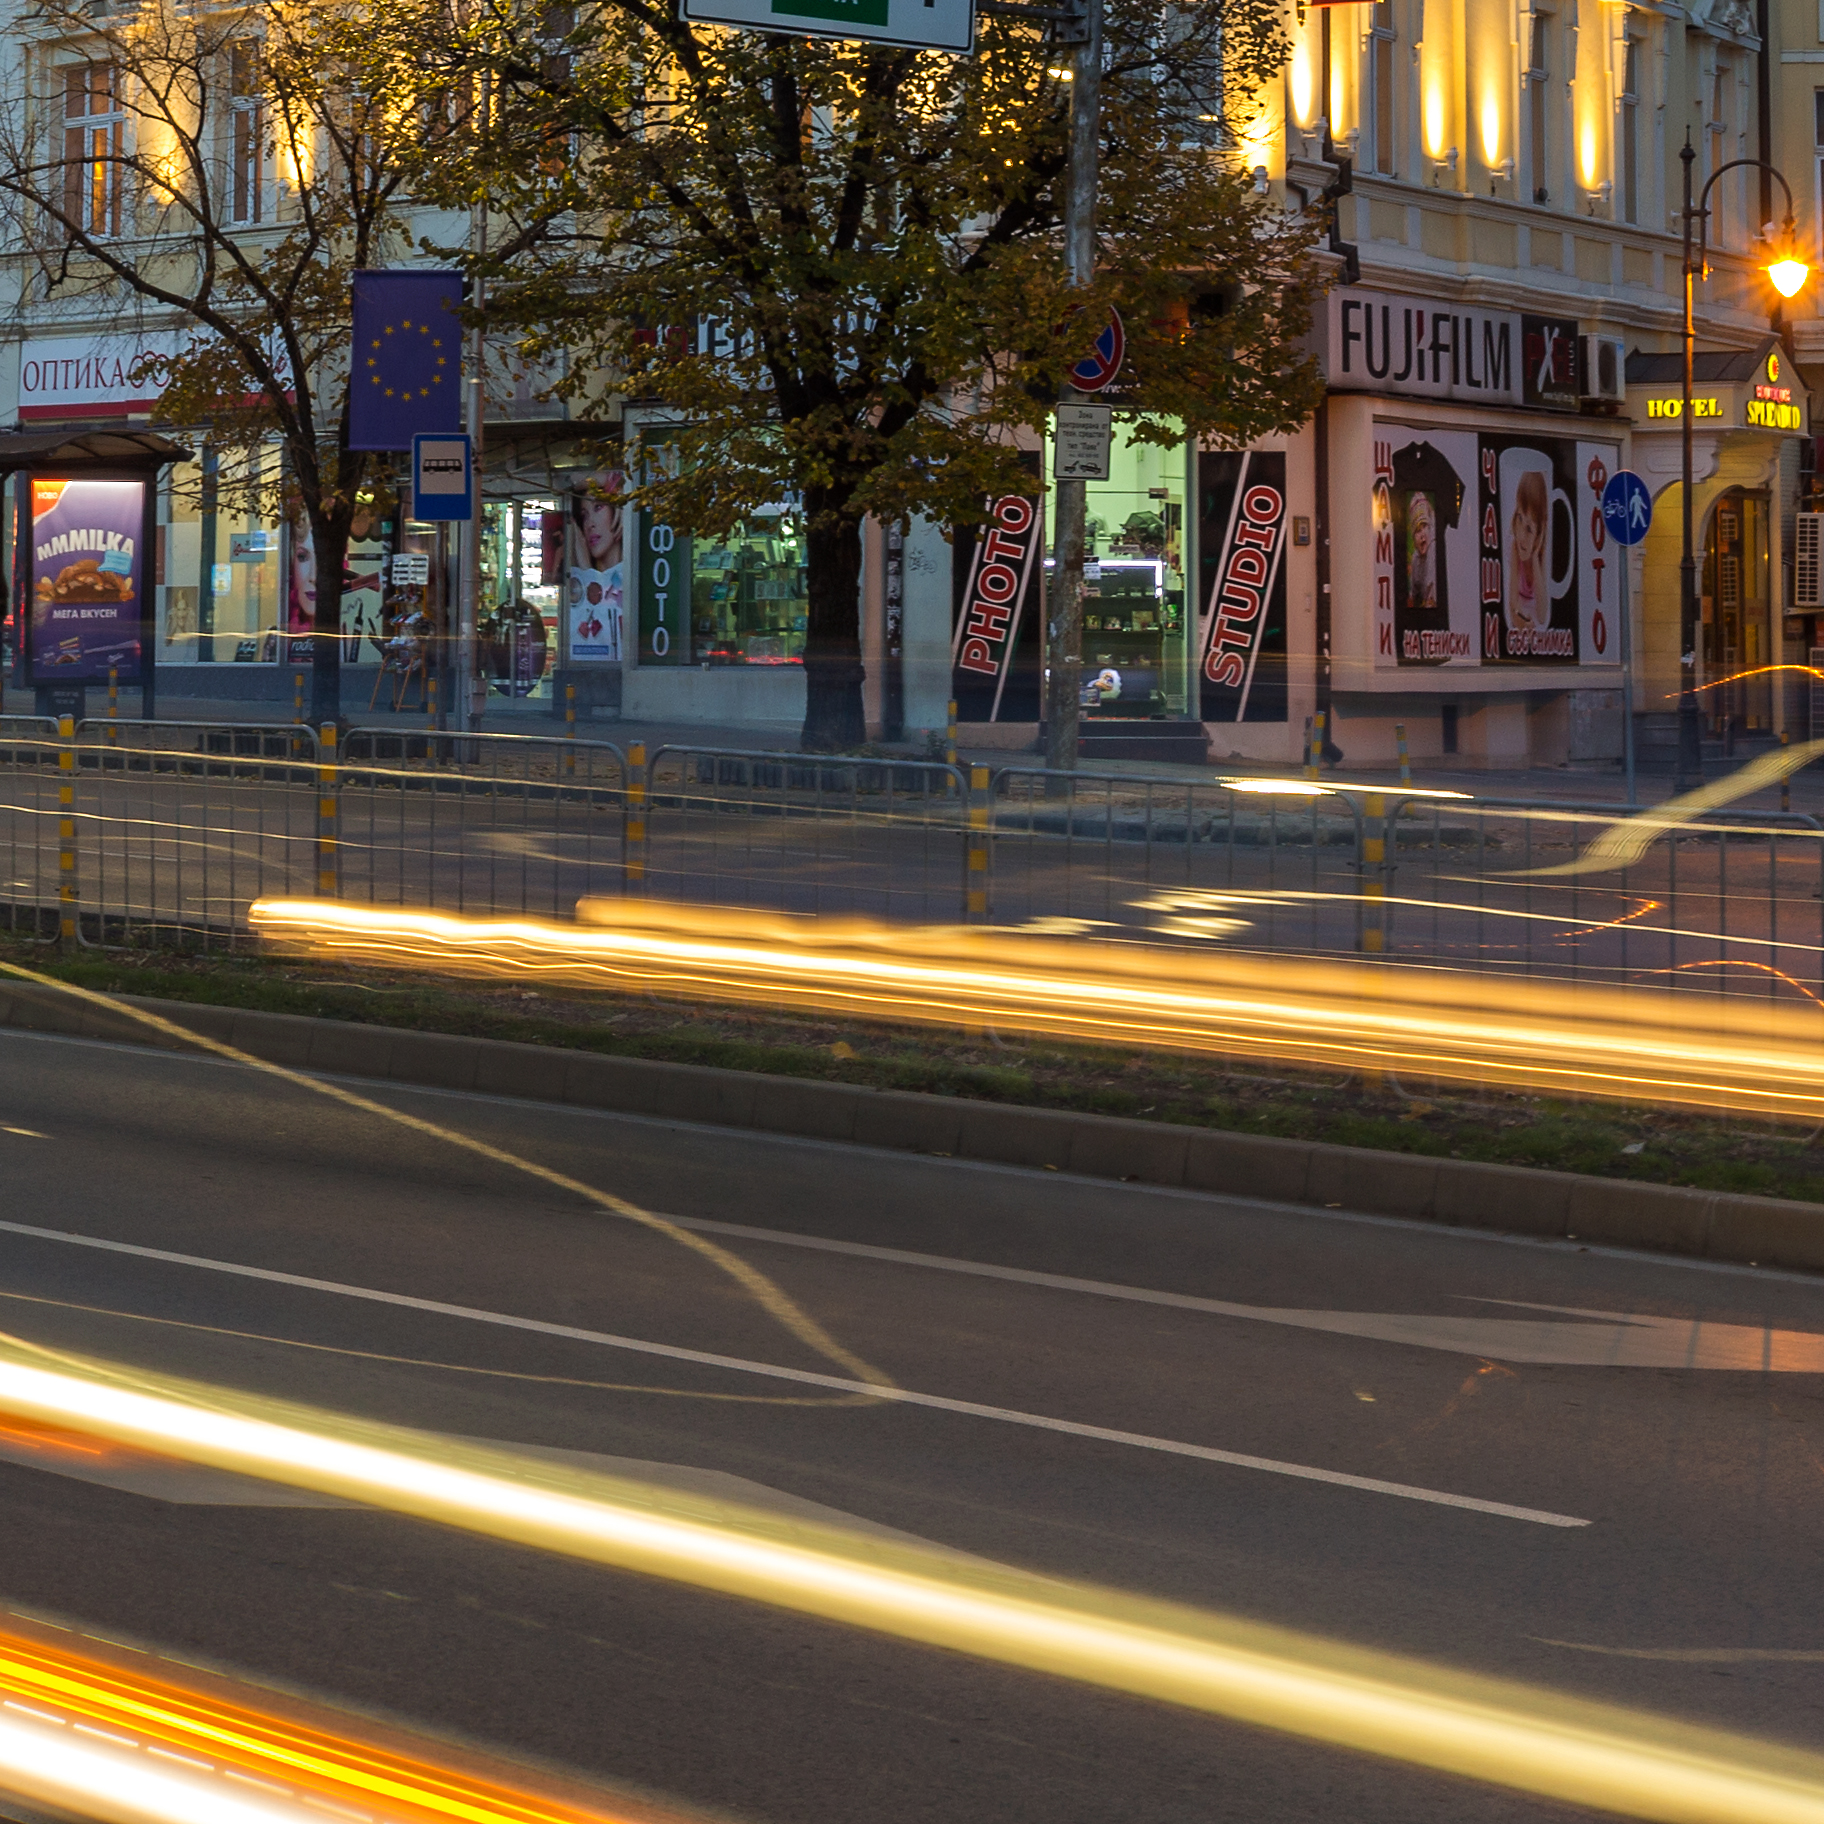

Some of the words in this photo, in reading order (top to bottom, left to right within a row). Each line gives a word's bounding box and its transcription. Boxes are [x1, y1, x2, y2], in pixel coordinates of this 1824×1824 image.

[22, 357, 126, 393] ОПТИКА
[37, 491, 58, 500] НОВО
[36, 528, 135, 562] MMMILKA
[960, 495, 1033, 676] PHOTO
[1205, 485, 1283, 687] STUDIO
[1374, 440, 1396, 657] ЩАМПИ
[1481, 447, 1501, 659] ЧАШИ
[1588, 455, 1608, 654] ФОТО
[52, 609, 79, 619] МЕГА
[80, 608, 118, 619] ВКУСЕН
[649, 524, 674, 657] ФОТО
[1402, 629, 1421, 659] НА
[1421, 630, 1471, 659] ТЕНИСКИ
[1531, 628, 1574, 656] СНИМКА
